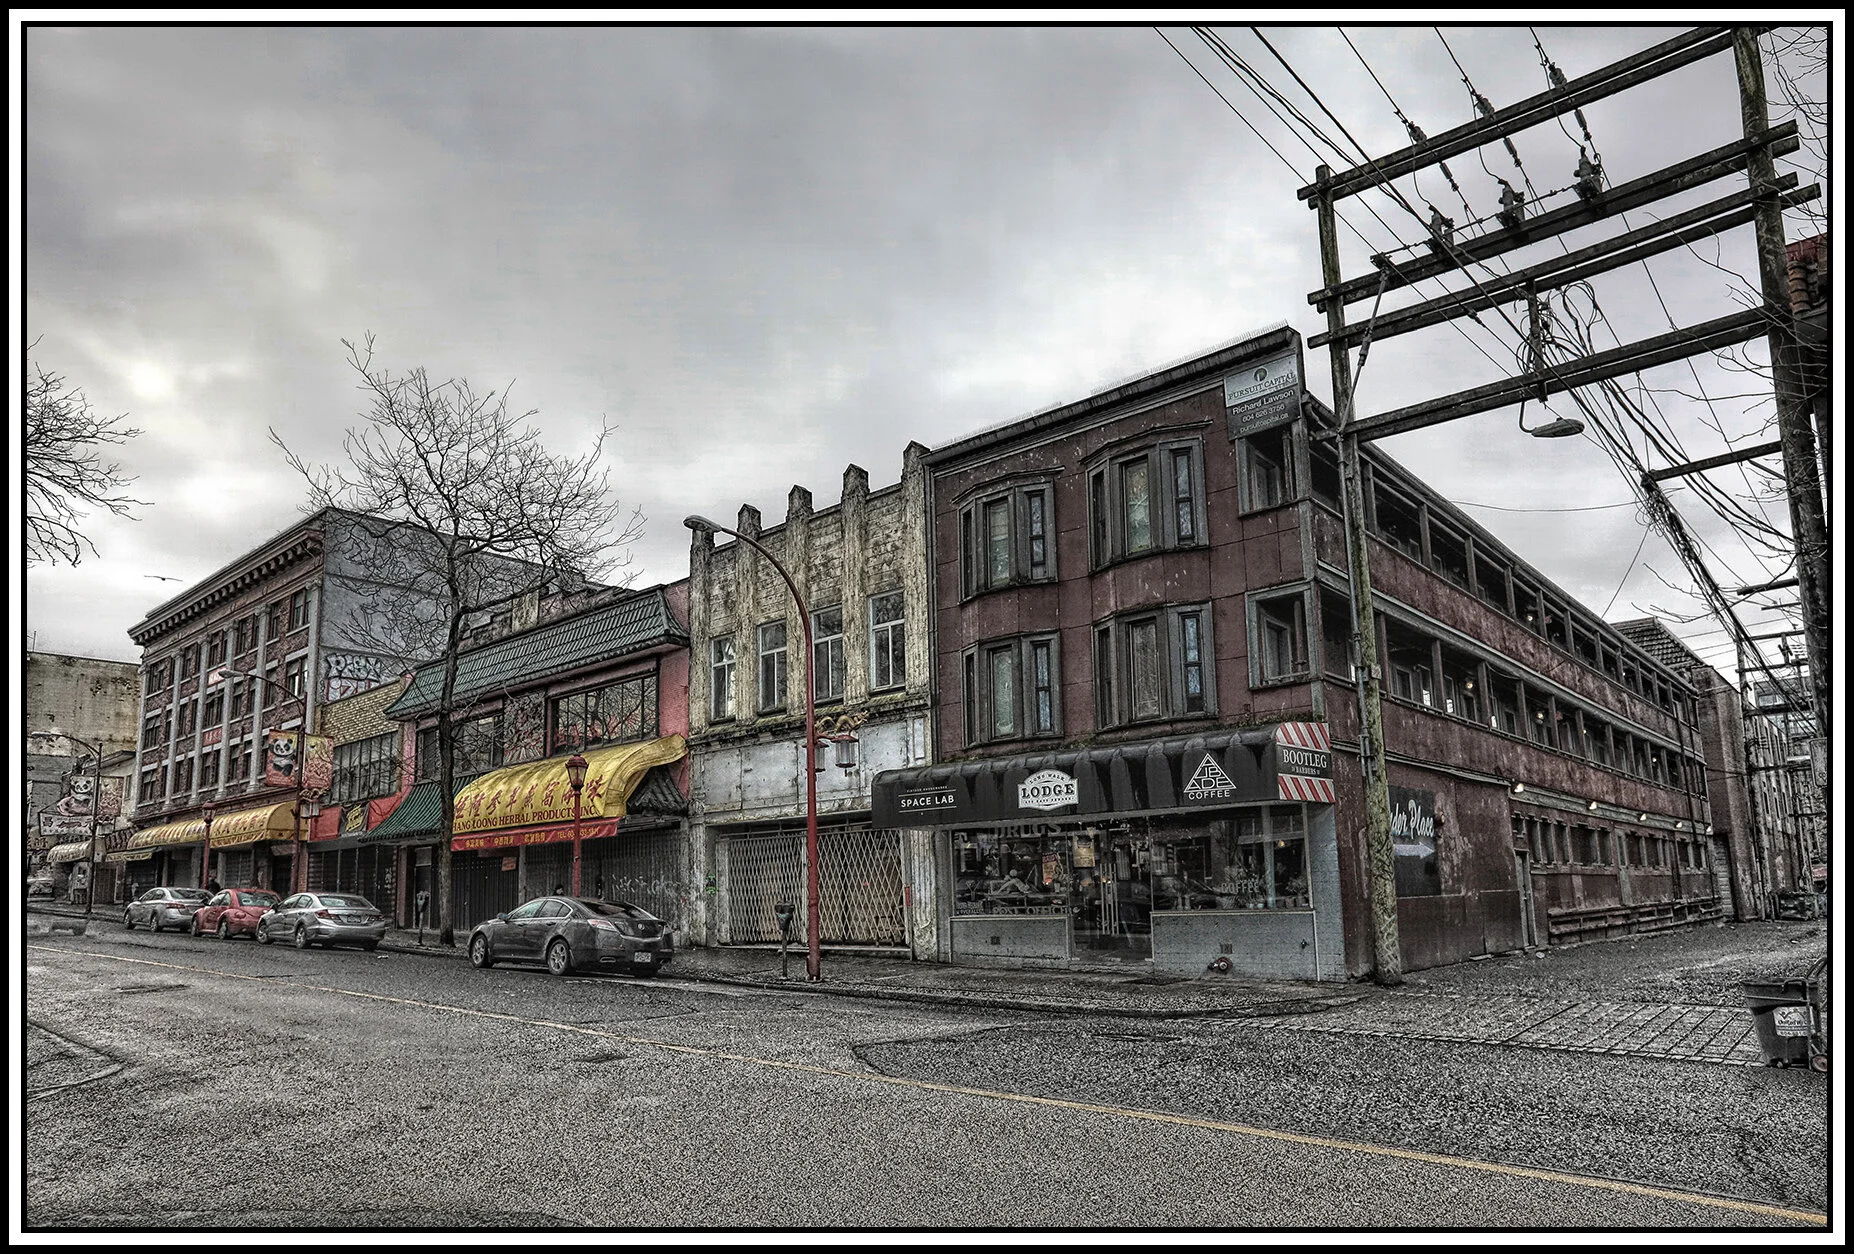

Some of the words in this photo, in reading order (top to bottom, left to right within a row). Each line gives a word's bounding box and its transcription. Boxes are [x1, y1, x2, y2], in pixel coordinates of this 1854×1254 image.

[1228, 383, 1264, 400] PURSUIT
[1264, 372, 1296, 388] CAPITAL
[1232, 400, 1262, 415] Richard
[1263, 389, 1294, 405] Lawson
[1242, 413, 1255, 423] 604
[1283, 749, 1327, 768] BOOTLEG
[1047, 773, 1065, 782] WALK
[1021, 783, 1075, 799] LODGE
[1188, 790, 1230, 800] COFFEE
[900, 796, 932, 808] SPACE
[935, 794, 955, 804] LAB
[472, 817, 497, 829] LOONG
[498, 812, 531, 826] HERBAL
[532, 806, 576, 822] PRODUCTS
[1408, 799, 1435, 839] Place
[1221, 880, 1260, 894] COFFEE
